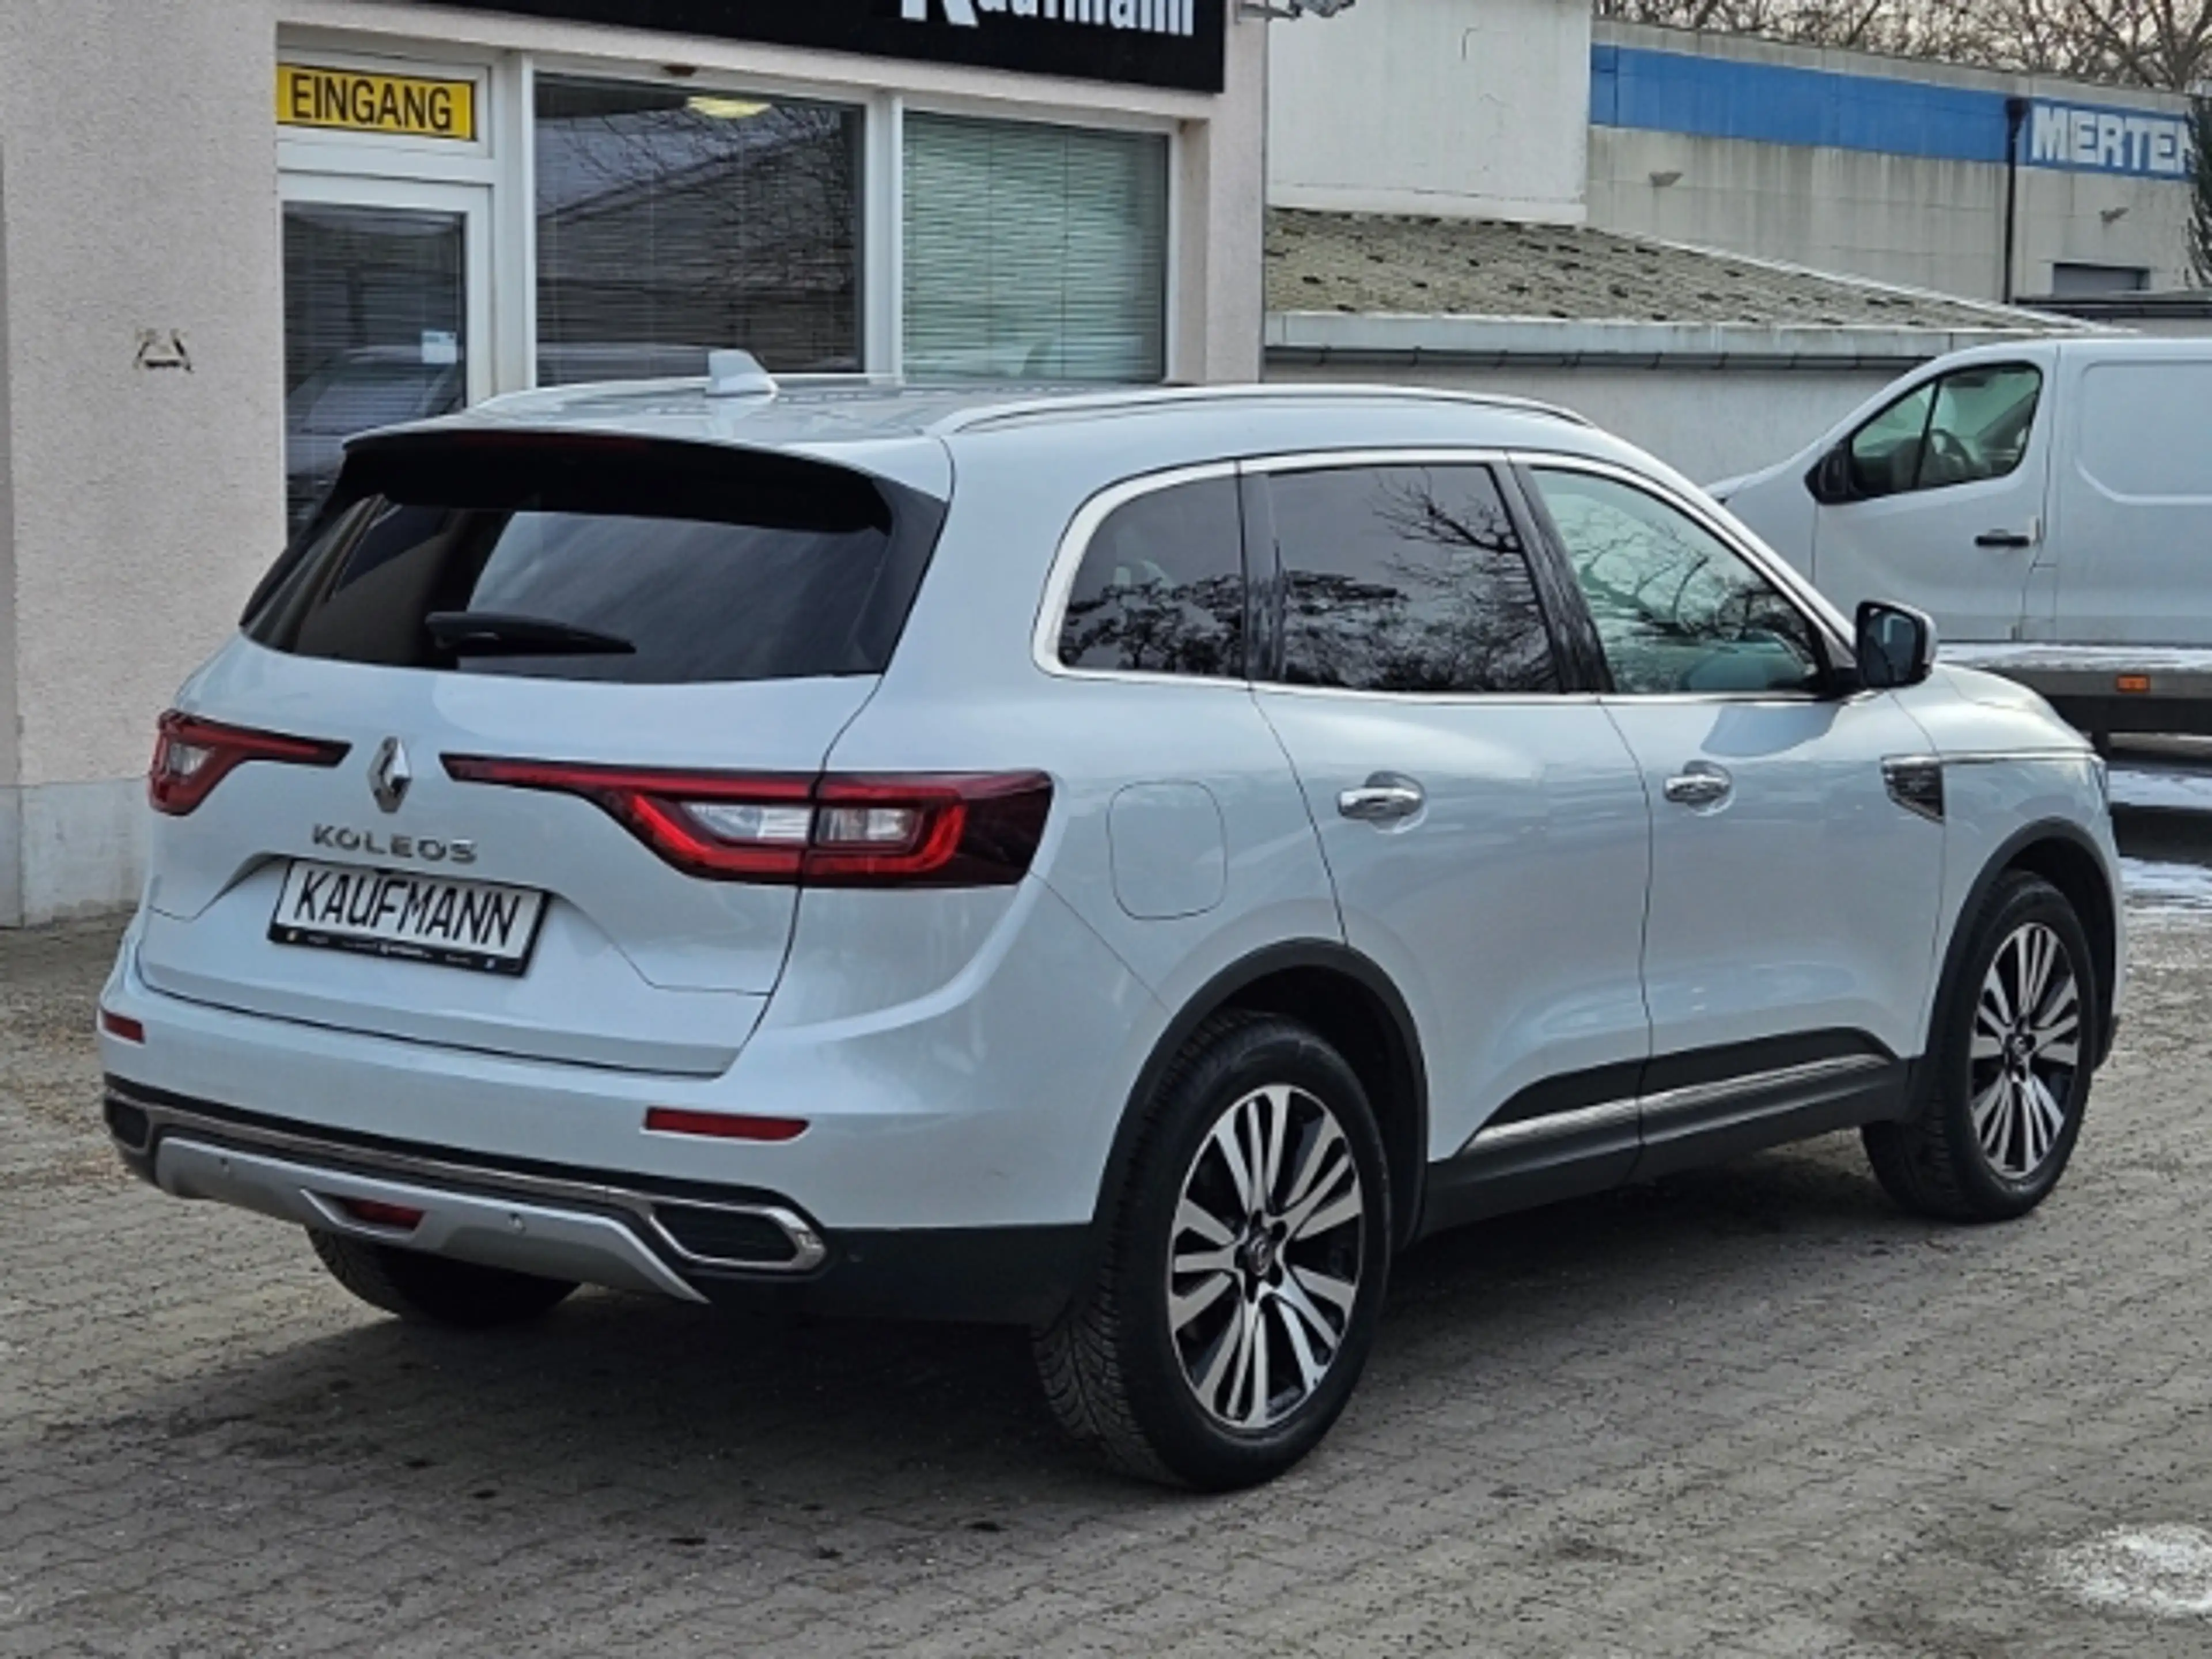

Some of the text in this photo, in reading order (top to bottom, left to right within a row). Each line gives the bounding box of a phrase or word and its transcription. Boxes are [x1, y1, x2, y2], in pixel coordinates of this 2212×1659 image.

[291, 73, 451, 131] EINGANG
[312, 823, 478, 863] KOLEOS
[294, 870, 521, 947] KAUFMANN
